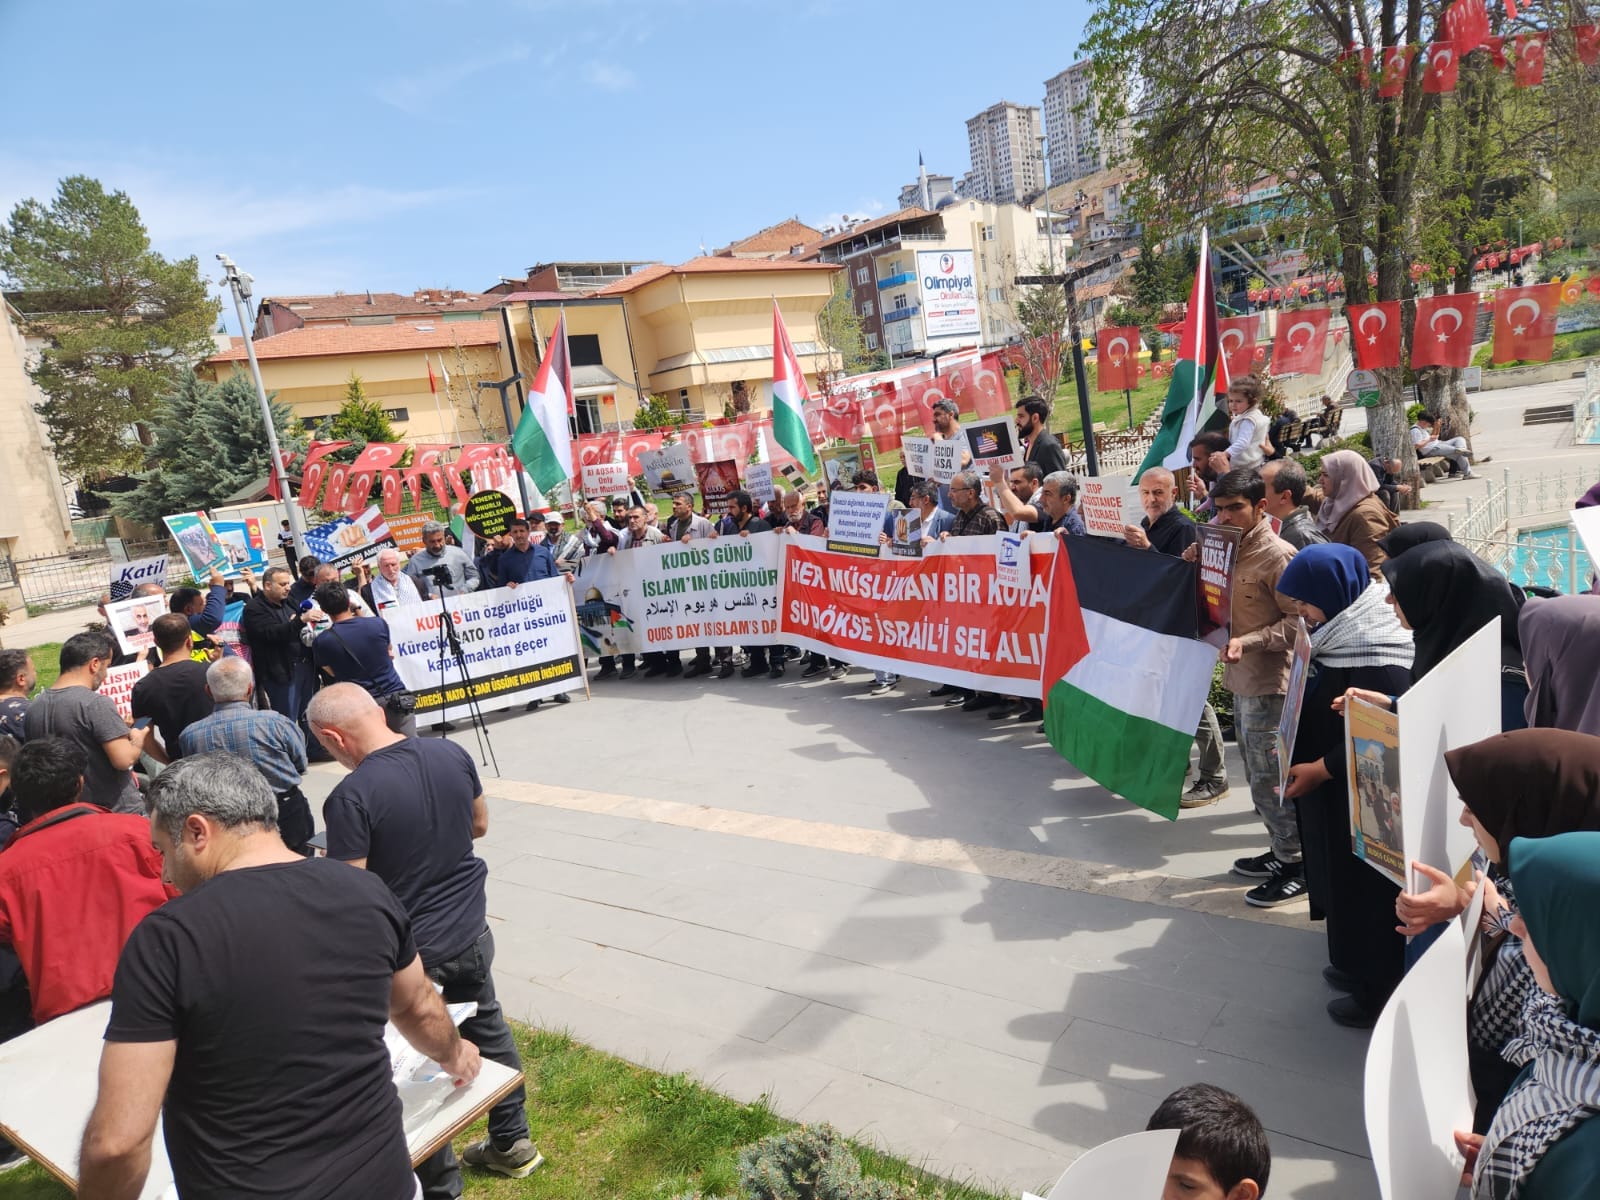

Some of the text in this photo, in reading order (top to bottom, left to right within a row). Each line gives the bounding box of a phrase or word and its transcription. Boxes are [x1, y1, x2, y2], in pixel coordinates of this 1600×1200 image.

[925, 275, 972, 291] Olimpiyat
[935, 445, 954, 457] ESCİDİ
[596, 466, 614, 476] AQSA
[1085, 483, 1102, 494] STOP
[466, 505, 515, 523] MÜCADELESİNE
[482, 517, 504, 528] SELAM
[364, 540, 394, 559] AMERİKA
[661, 542, 753, 570] KUDÜS GÜNÜ
[121, 559, 165, 582] Katil
[642, 567, 778, 598] İSLAM'IN GÜNÜDÜR
[791, 559, 1048, 608] HER MÜSLÜMAN BİR KOVA
[683, 600, 705, 616] يوم
[724, 592, 757, 611] القدس
[761, 595, 777, 613] وم
[416, 594, 543, 632] KUDS'ün özgürlüğü
[398, 635, 448, 657] Kürecik
[488, 621, 521, 639] radar
[524, 610, 567, 632] üssünü
[647, 618, 777, 643] QUDS DAY IS ISLAM'S DA
[790, 599, 809, 626] SU
[810, 604, 873, 642] DÖKSE
[954, 626, 991, 661] SEL
[427, 636, 549, 673] kapamaktan geçer
[102, 669, 141, 686] LİSTİN
[445, 686, 466, 703] NATO
[468, 681, 491, 698] RDAR
[491, 674, 520, 694] ÜSSÜNE
[520, 669, 542, 686] HAYIR
[99, 681, 137, 696] HALK
